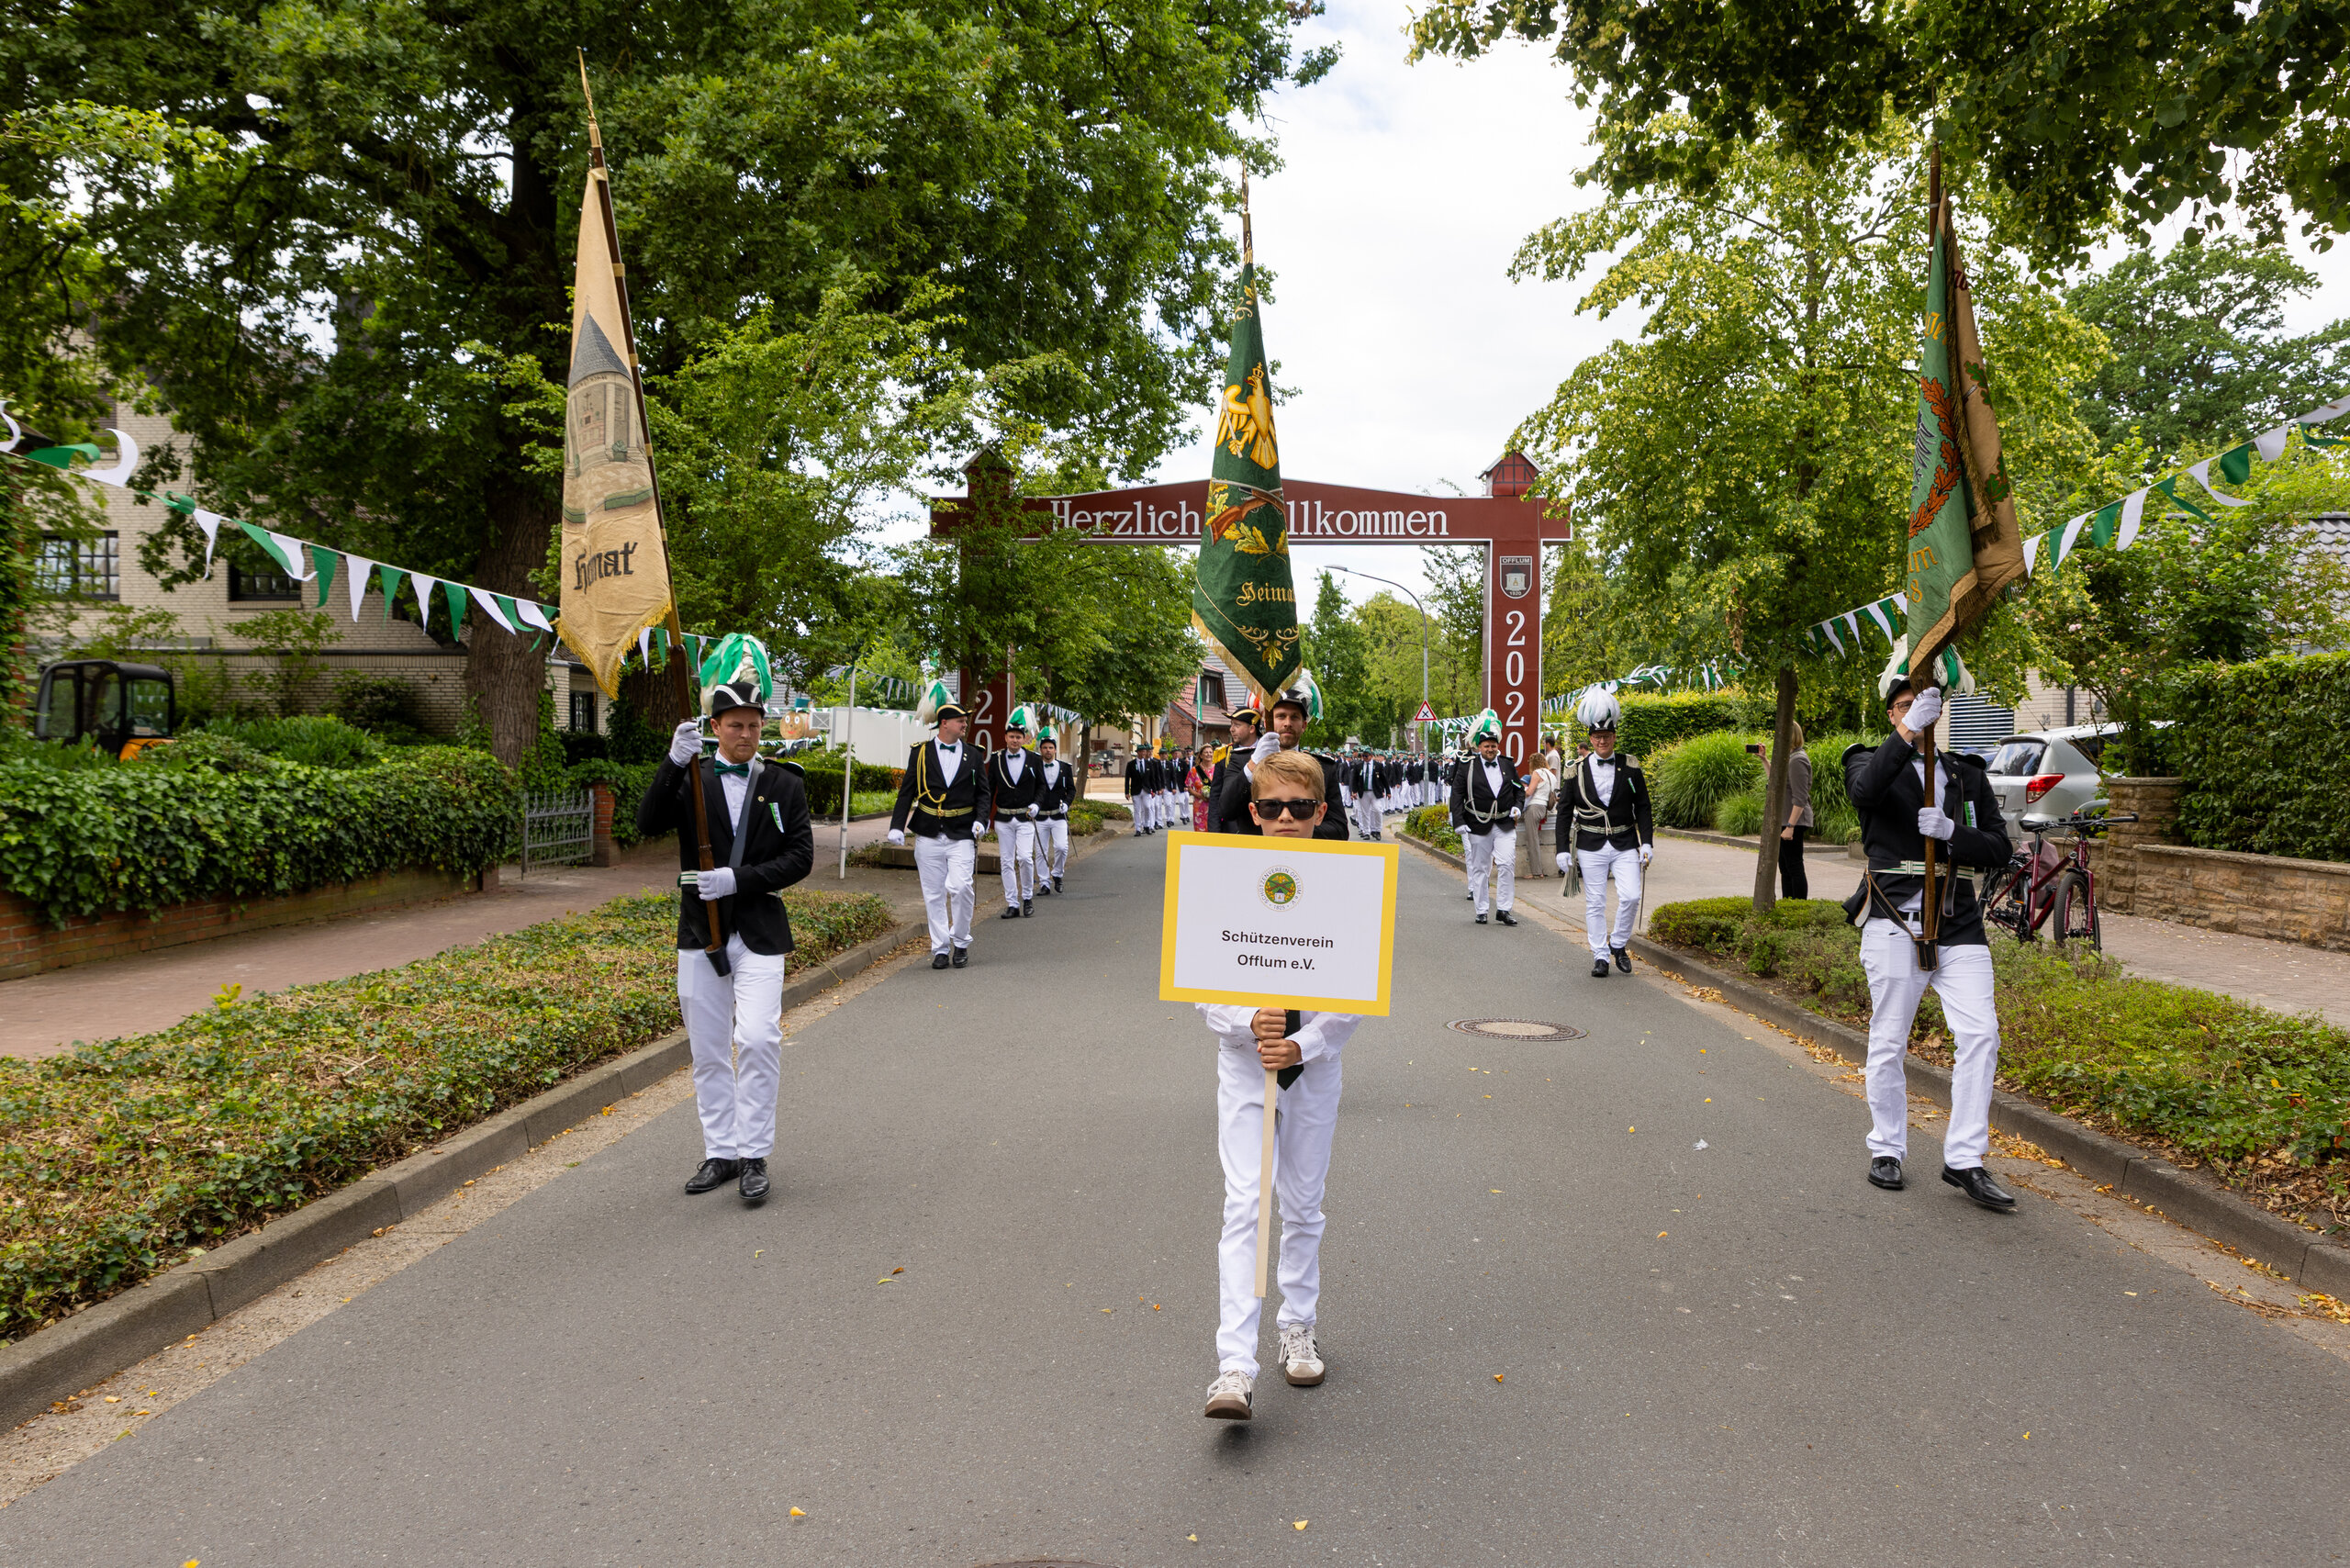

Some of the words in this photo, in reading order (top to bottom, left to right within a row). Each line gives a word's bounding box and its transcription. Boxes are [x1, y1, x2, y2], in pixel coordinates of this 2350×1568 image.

[1050, 500, 1201, 535] Herzlich
[1505, 610, 1526, 767] 2020
[1290, 871, 1302, 895] OFFLUM
[1221, 930, 1334, 948] Schützenverein
[1237, 954, 1287, 969] Offlum
[1291, 958, 1315, 970] e.V.
